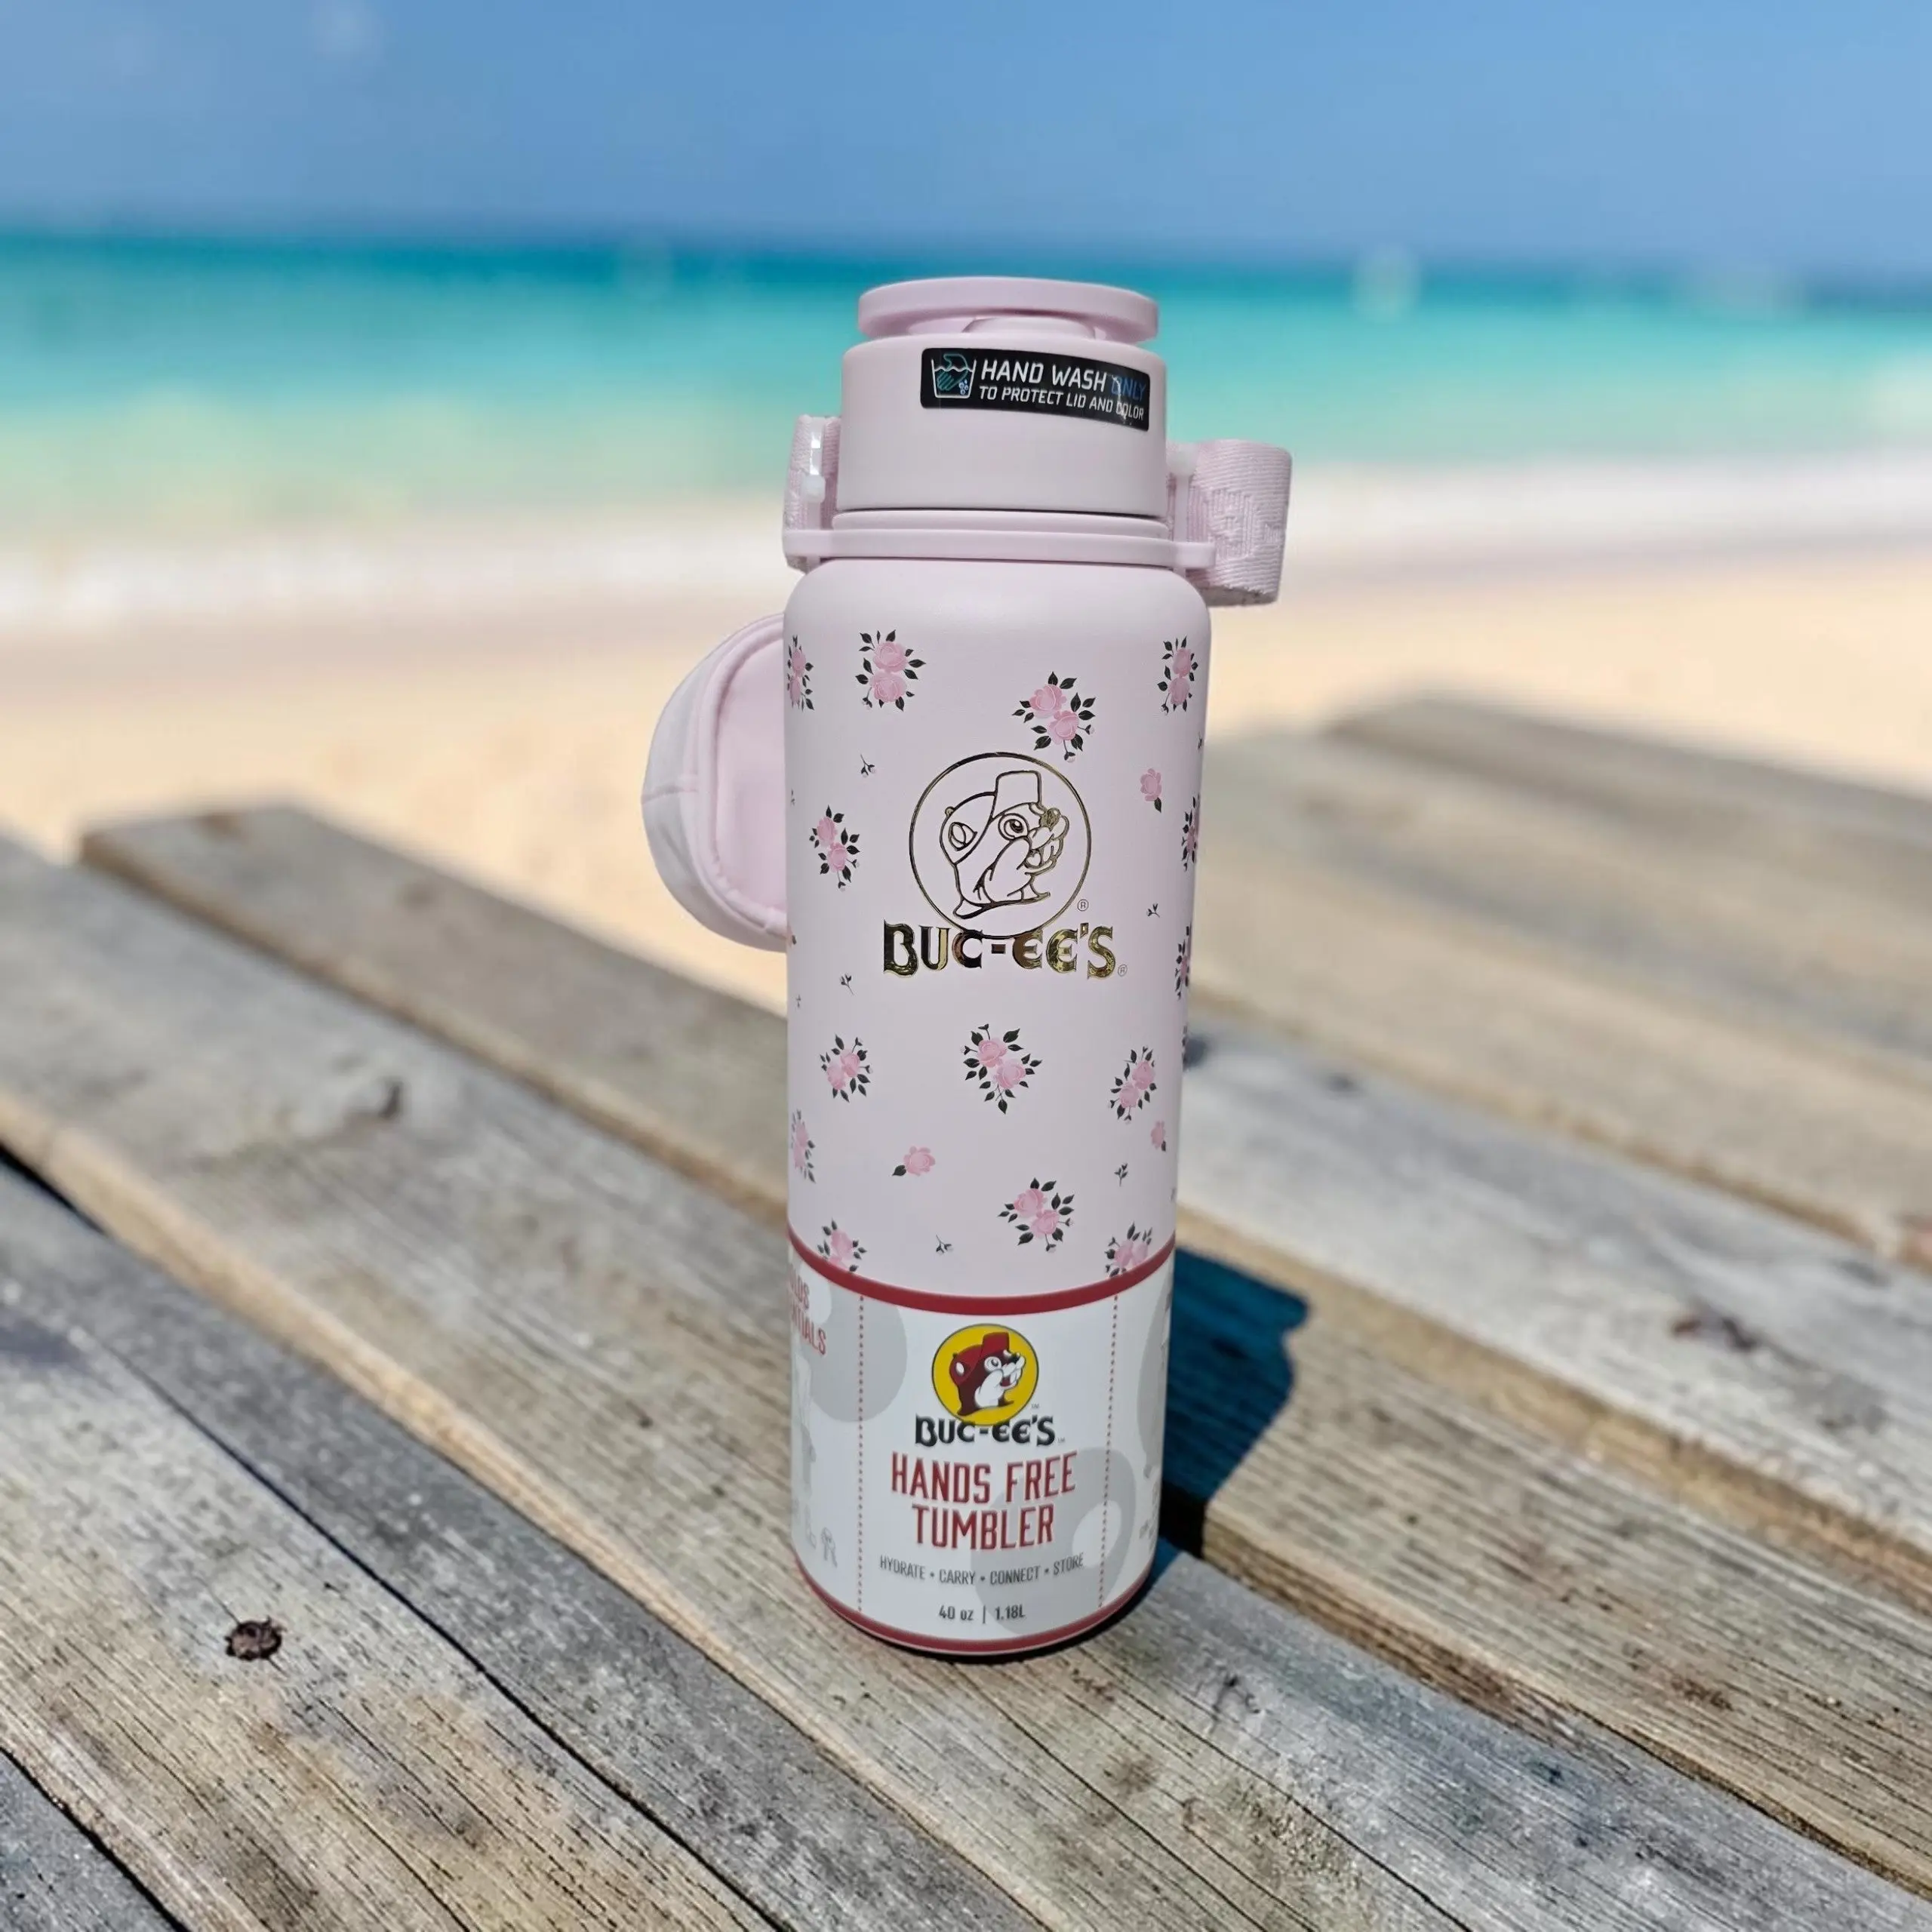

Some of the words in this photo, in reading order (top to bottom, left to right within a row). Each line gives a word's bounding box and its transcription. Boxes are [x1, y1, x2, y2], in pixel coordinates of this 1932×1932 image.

[981, 358, 1044, 384] HAND
[1051, 365, 1107, 393] WASH
[1111, 375, 1146, 401] ONLY
[980, 385, 997, 401] TO
[1001, 387, 1063, 406] PROTECT
[1066, 392, 1086, 408] LID
[1089, 396, 1114, 414] AND
[1115, 401, 1145, 420] COLOR
[883, 918, 1117, 980] BUC-EE'S
[914, 1414, 1056, 1447] BUC-EE'S
[891, 1451, 992, 1505] HANDS
[1005, 1450, 1078, 1503] FREE
[911, 1503, 1055, 1550] TUMBLER
[879, 1553, 926, 1580] HYDRATE
[938, 1568, 977, 1586] CARRY
[989, 1564, 1041, 1586] CONNECT
[1052, 1552, 1084, 1577] STORE
[938, 1604, 956, 1620] 40
[959, 1608, 975, 1622] oz
[994, 1602, 1026, 1621] 1.18L
